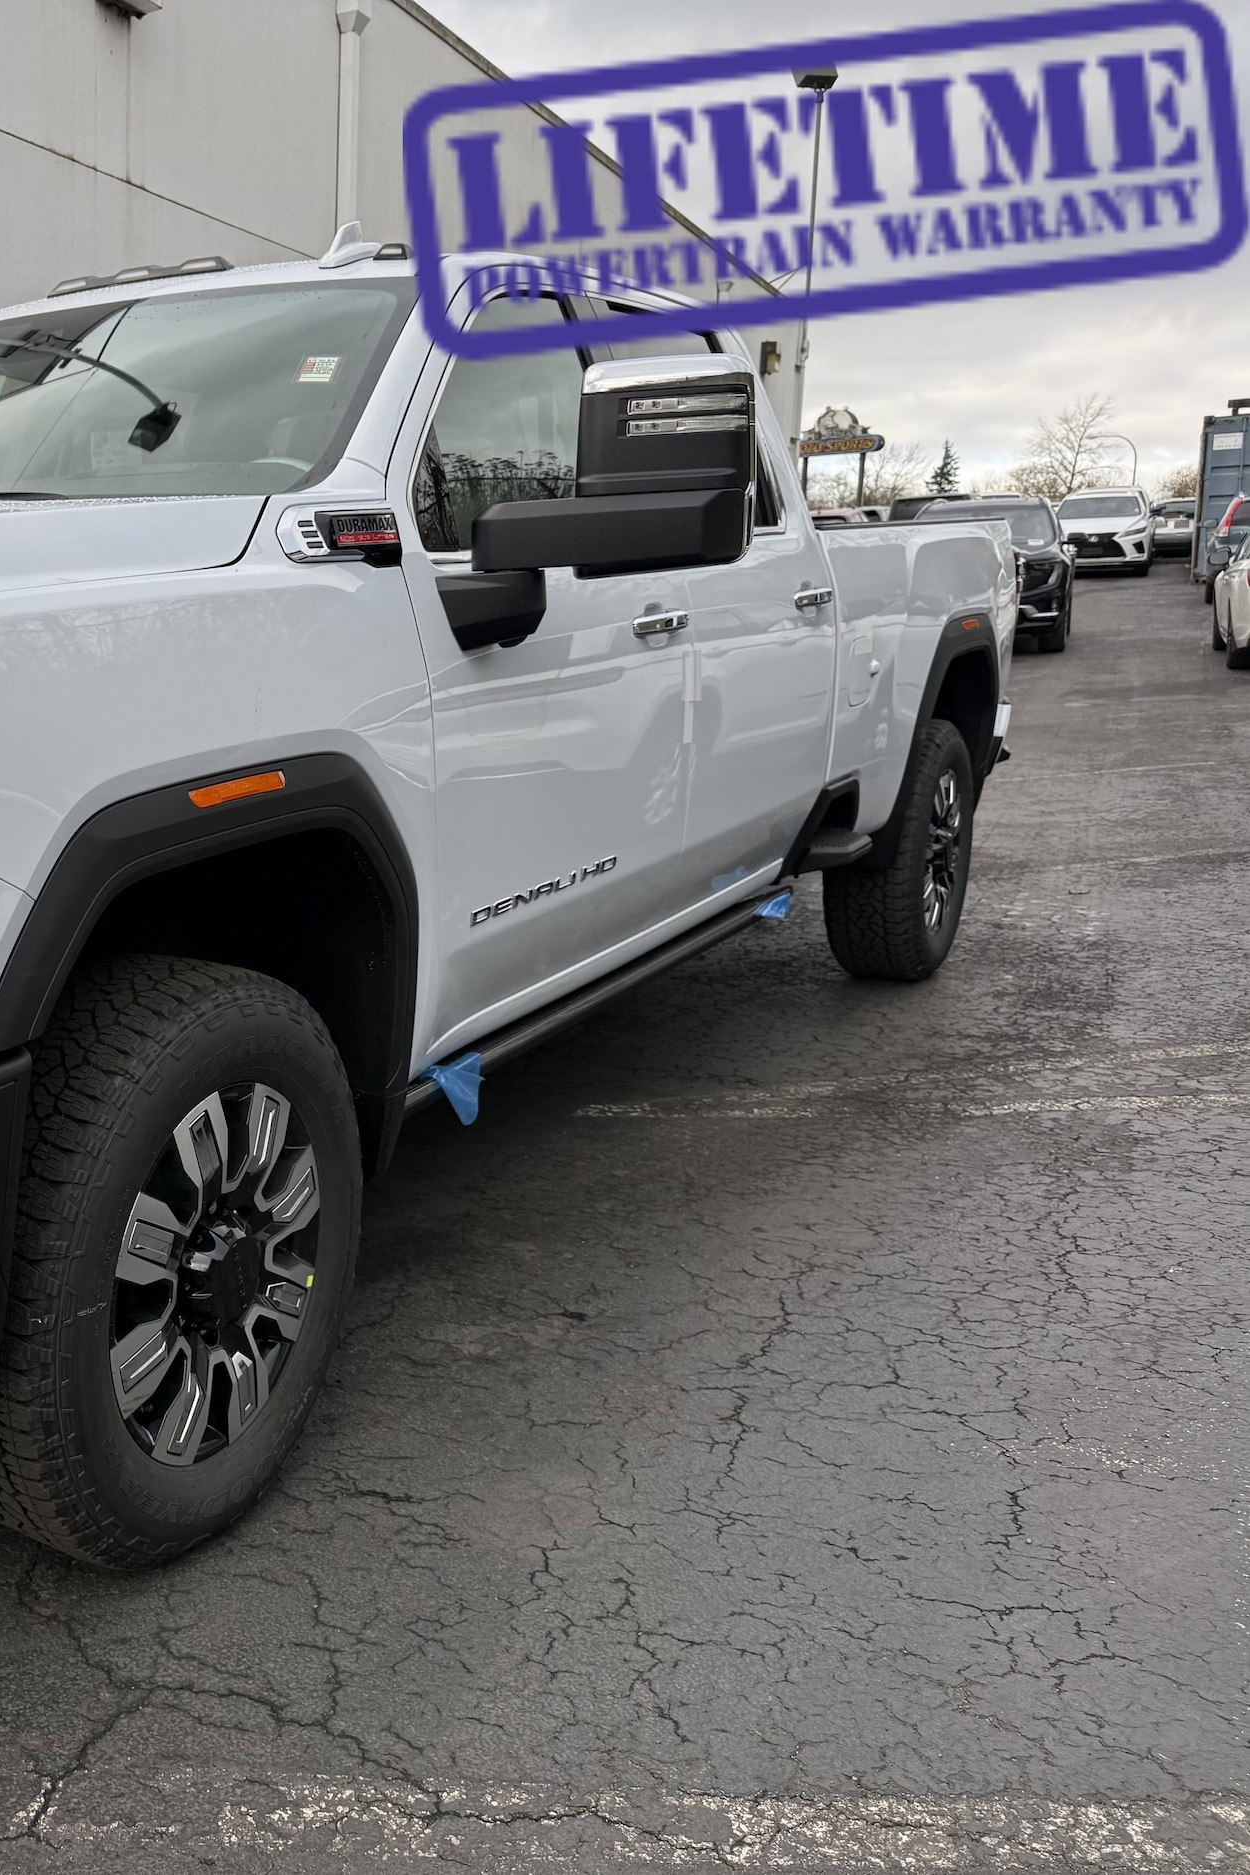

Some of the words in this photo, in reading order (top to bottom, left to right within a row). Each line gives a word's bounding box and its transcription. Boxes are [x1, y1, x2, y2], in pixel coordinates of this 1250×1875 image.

[826, 437, 874, 452] SPORTS
[337, 517, 393, 533] DURAMAX
[470, 870, 577, 928] DENALI
[580, 854, 618, 882] HD
[178, 1033, 350, 1128] WRANGLER
